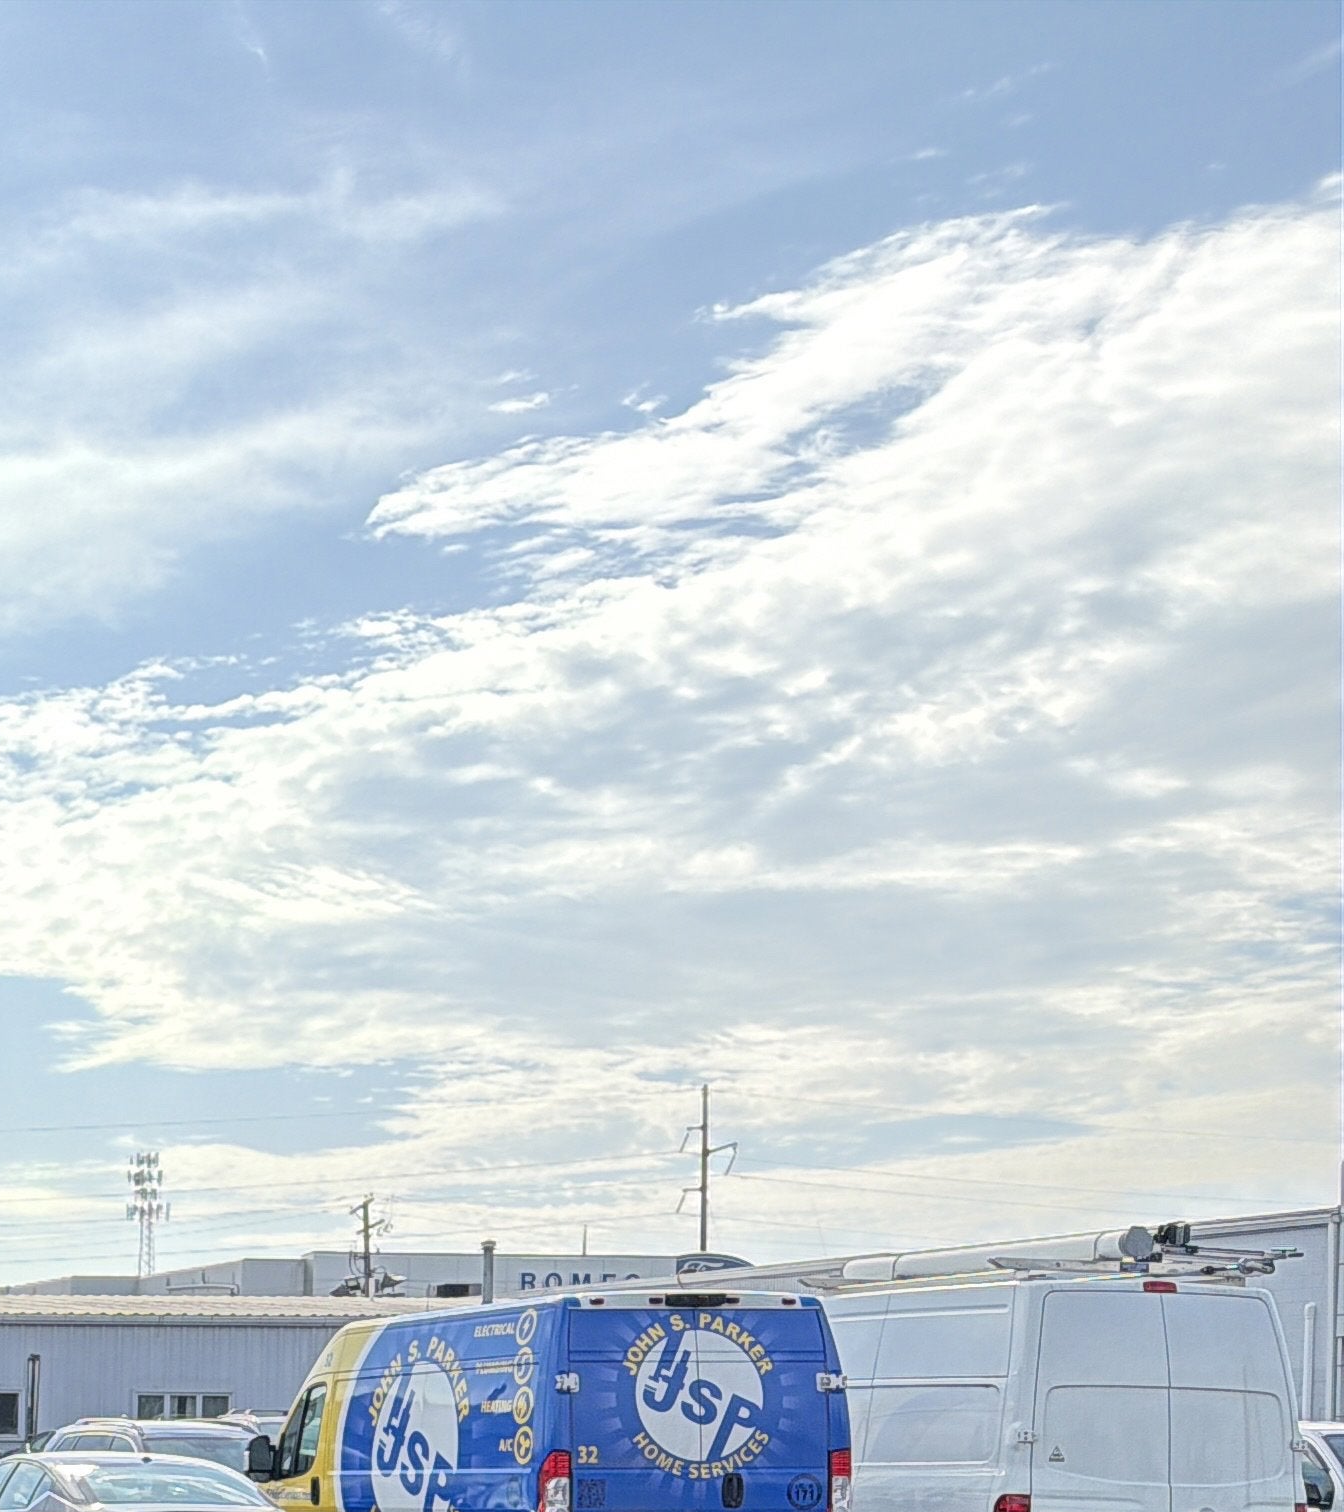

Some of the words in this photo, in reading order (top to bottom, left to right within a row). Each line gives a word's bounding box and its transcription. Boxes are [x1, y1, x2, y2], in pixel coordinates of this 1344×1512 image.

[520, 1272, 641, 1290] ROM
[473, 1322, 516, 1338] ELECTRICAL
[622, 1323, 666, 1376] JOHN
[670, 1314, 691, 1331] S.
[699, 1313, 775, 1375] PARKER
[368, 1353, 402, 1427] JOHN
[426, 1336, 470, 1423] PARKER
[480, 1399, 514, 1414] HEATING
[498, 1437, 514, 1452] A/C
[577, 1446, 599, 1464] 32
[632, 1431, 682, 1477] HOME
[688, 1430, 769, 1479] SERVICES
